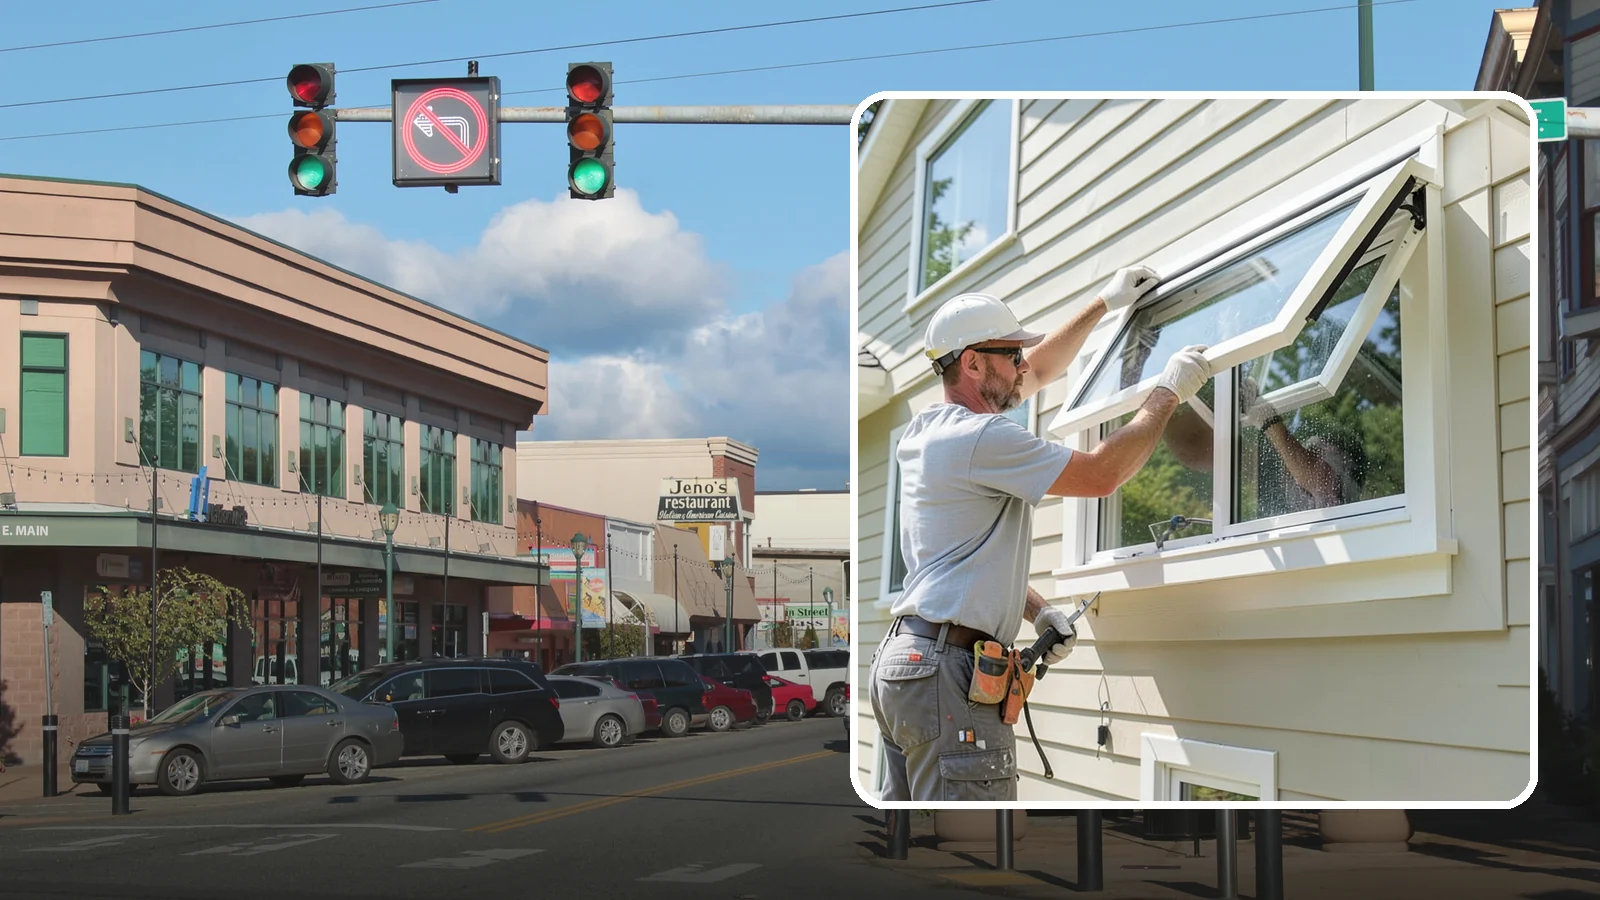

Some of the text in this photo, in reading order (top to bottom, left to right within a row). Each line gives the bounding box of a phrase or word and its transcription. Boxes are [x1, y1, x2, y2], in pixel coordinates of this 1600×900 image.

[670, 480, 727, 494] Jeno's
[665, 496, 731, 509] restaurant
[658, 510, 681, 519] Italian
[686, 510, 714, 519] American
[715, 509, 737, 519] Cuisine
[2, 525, 49, 536] E. MAIN
[797, 607, 828, 617] Street
[790, 619, 823, 627] lass
